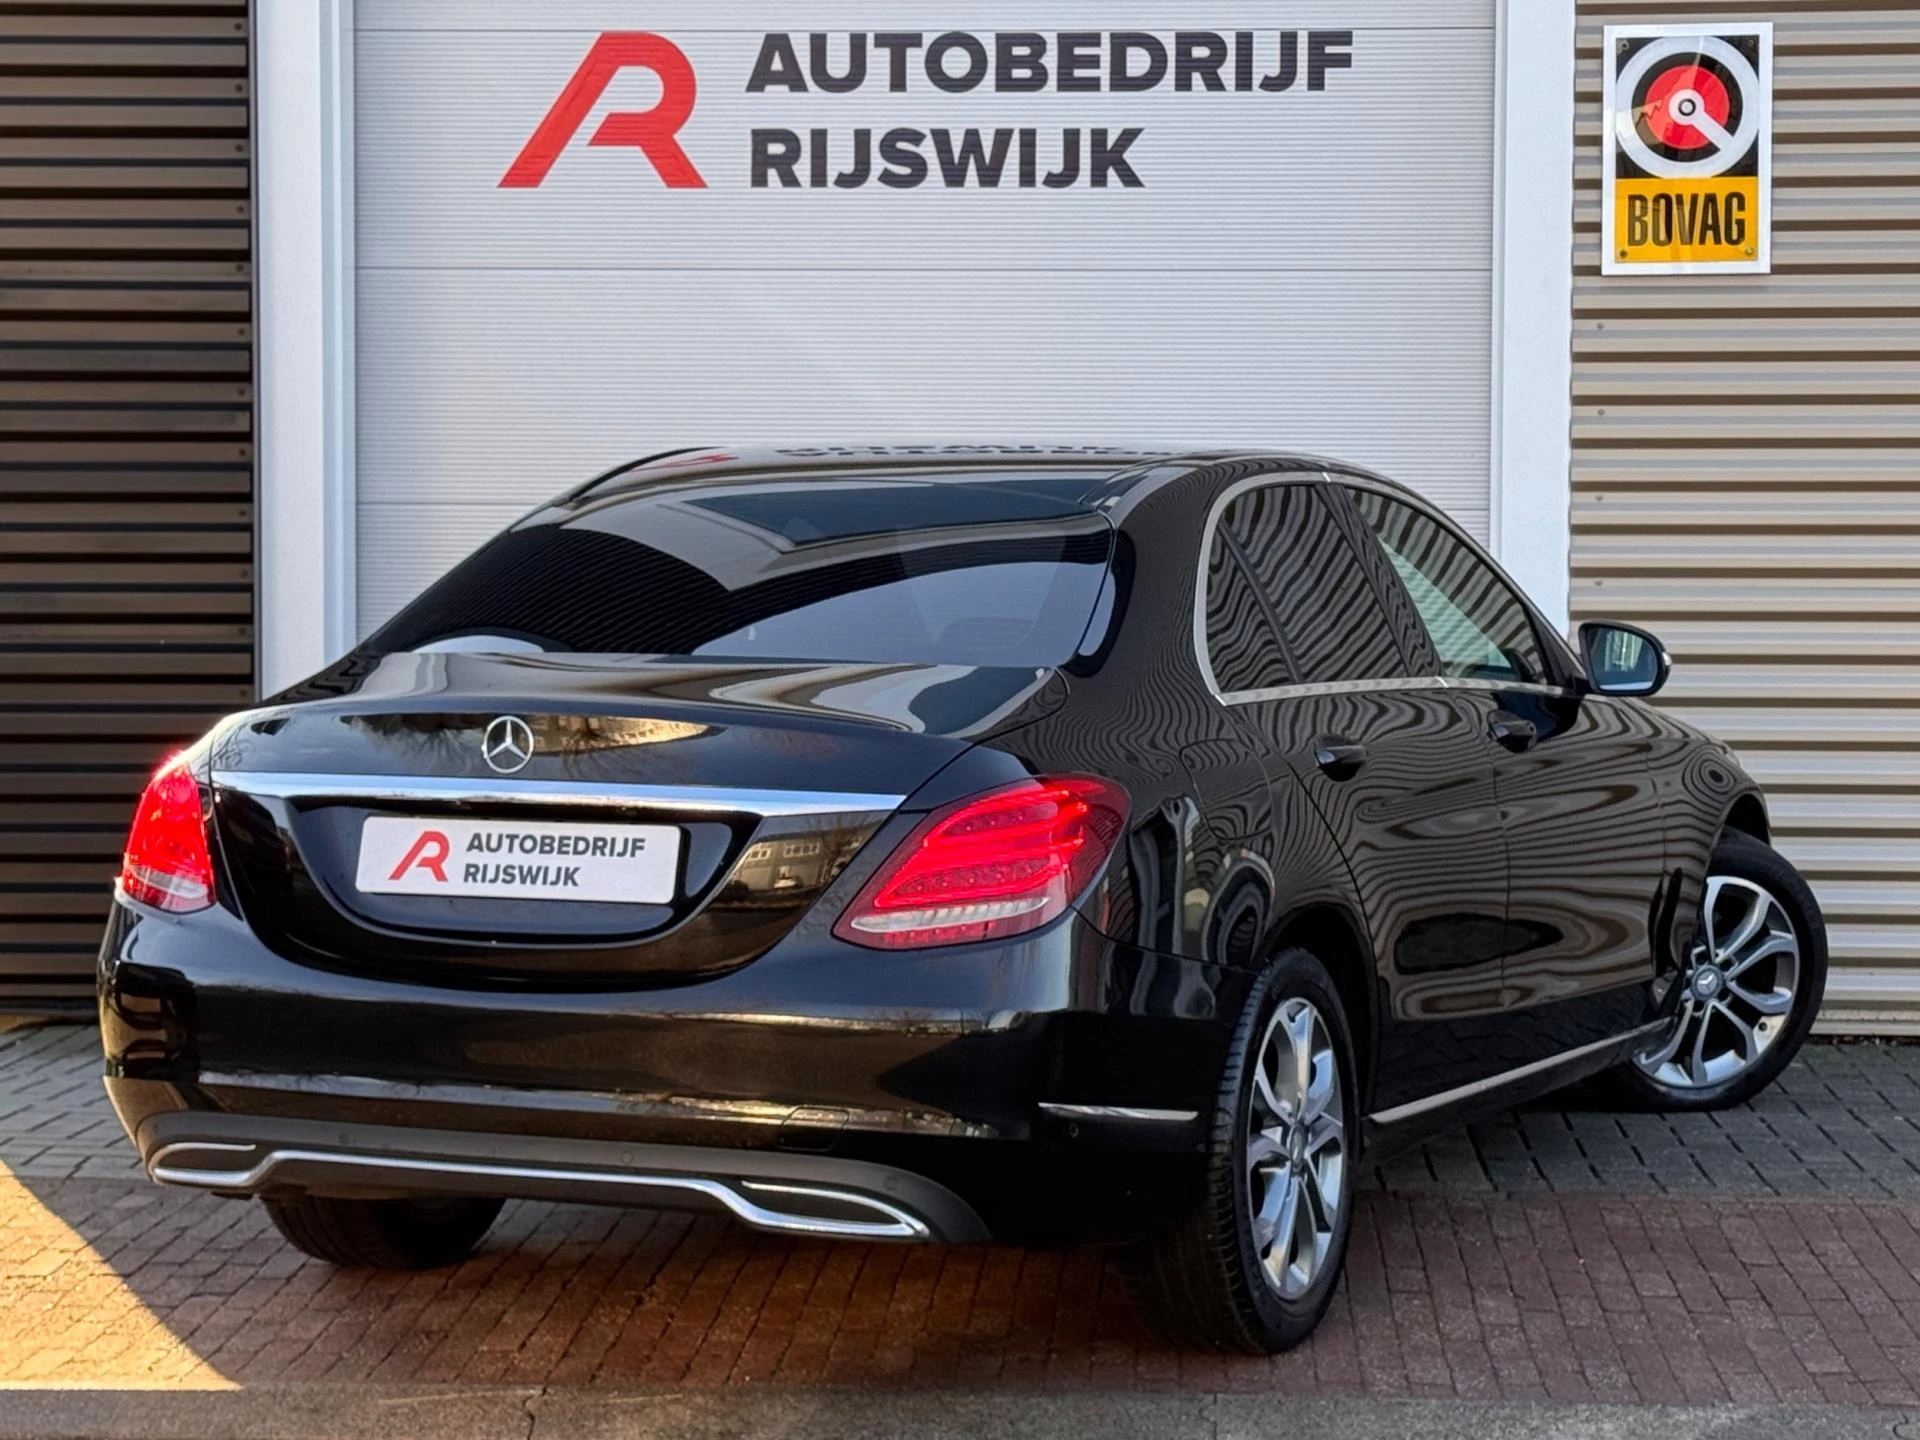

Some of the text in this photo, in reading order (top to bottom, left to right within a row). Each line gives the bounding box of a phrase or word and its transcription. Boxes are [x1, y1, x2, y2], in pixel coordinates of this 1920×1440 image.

[746, 31, 1352, 92] AUTOBEDRIJF
[752, 128, 1144, 188] RIJSWIJK
[1628, 192, 1745, 246] BOVAG
[466, 832, 646, 858] AUTOBEDRIJF
[463, 863, 580, 887] RIJSWIJK
